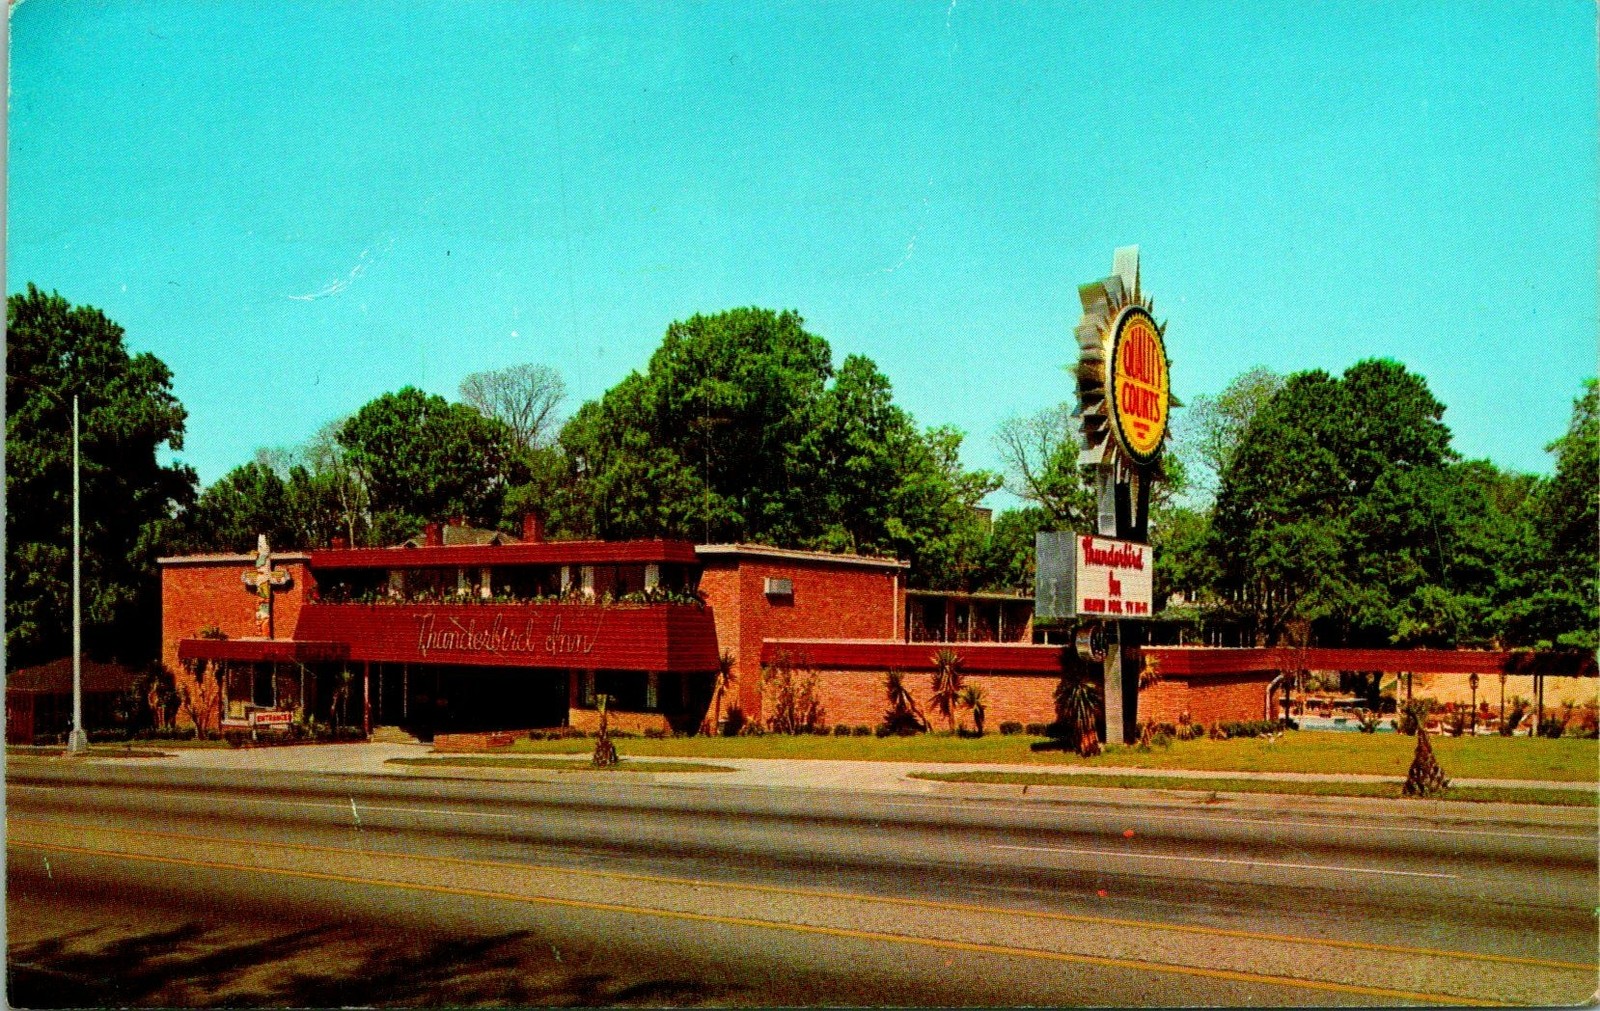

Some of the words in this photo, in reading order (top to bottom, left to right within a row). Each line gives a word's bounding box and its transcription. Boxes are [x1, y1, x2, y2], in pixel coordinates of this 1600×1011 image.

[1122, 381, 1160, 423] COURTS
[1082, 536, 1144, 571] Thunderbird
[413, 613, 535, 657] Thunderbird
[545, 610, 604, 656] Inn
